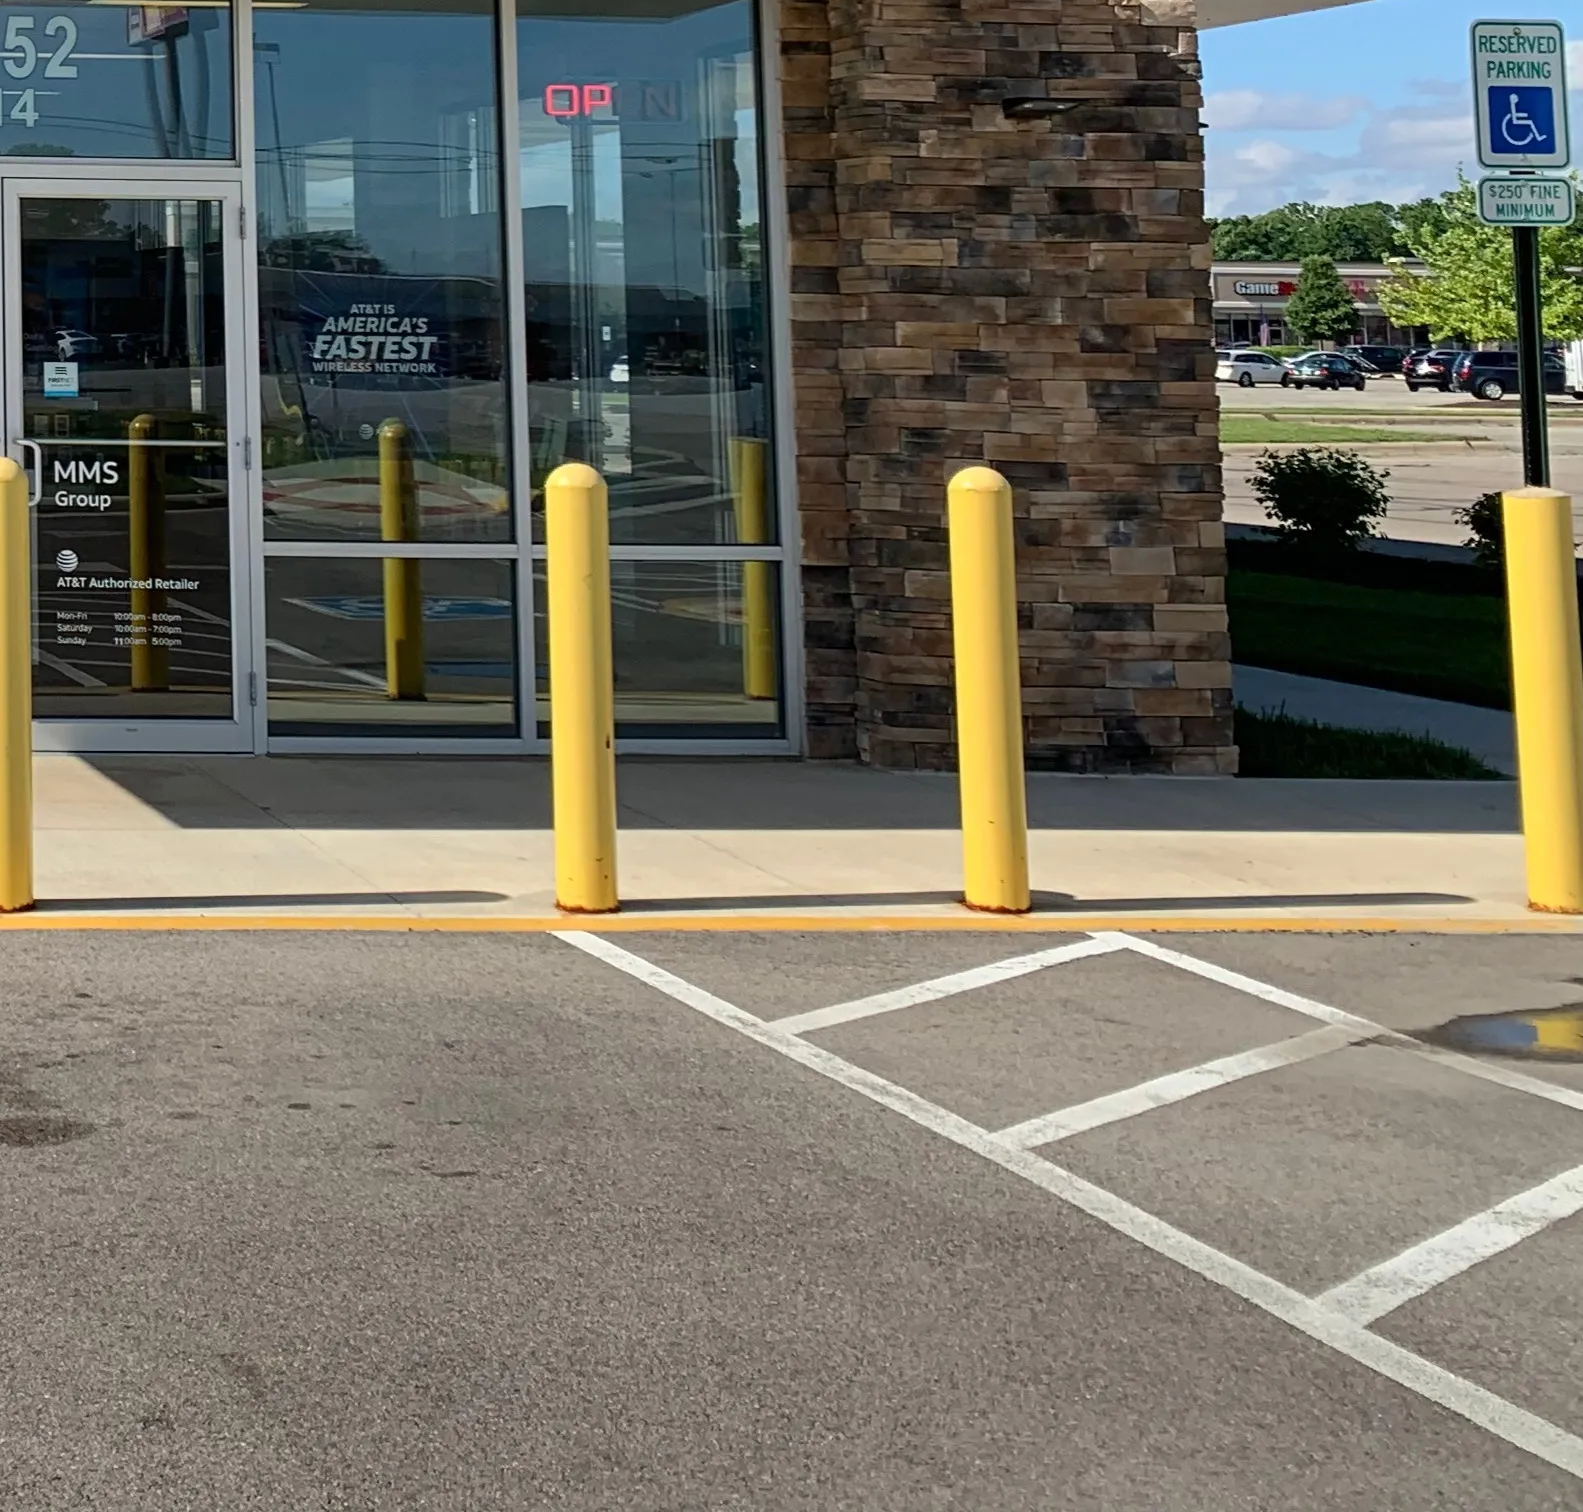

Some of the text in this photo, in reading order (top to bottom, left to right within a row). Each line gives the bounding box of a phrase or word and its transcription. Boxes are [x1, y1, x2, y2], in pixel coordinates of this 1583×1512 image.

[1478, 35, 1557, 54] RESERVED
[1487, 60, 1552, 80] PARKING
[1488, 185, 1561, 199] $250 FINE
[1496, 203, 1556, 217] MINIMUM
[350, 304, 395, 315] AT&T IS
[322, 317, 428, 333] AMERICA'S
[313, 336, 438, 360] FASTEST
[313, 362, 437, 374] WIRELESS NETWORK
[54, 460, 119, 484] MMS
[54, 490, 112, 512] Group
[57, 577, 200, 590] AT&T Authorized Retailer
[57, 611, 88, 620] Mon-Fri
[57, 623, 93, 635] Saturday
[57, 635, 87, 646] Sunday
